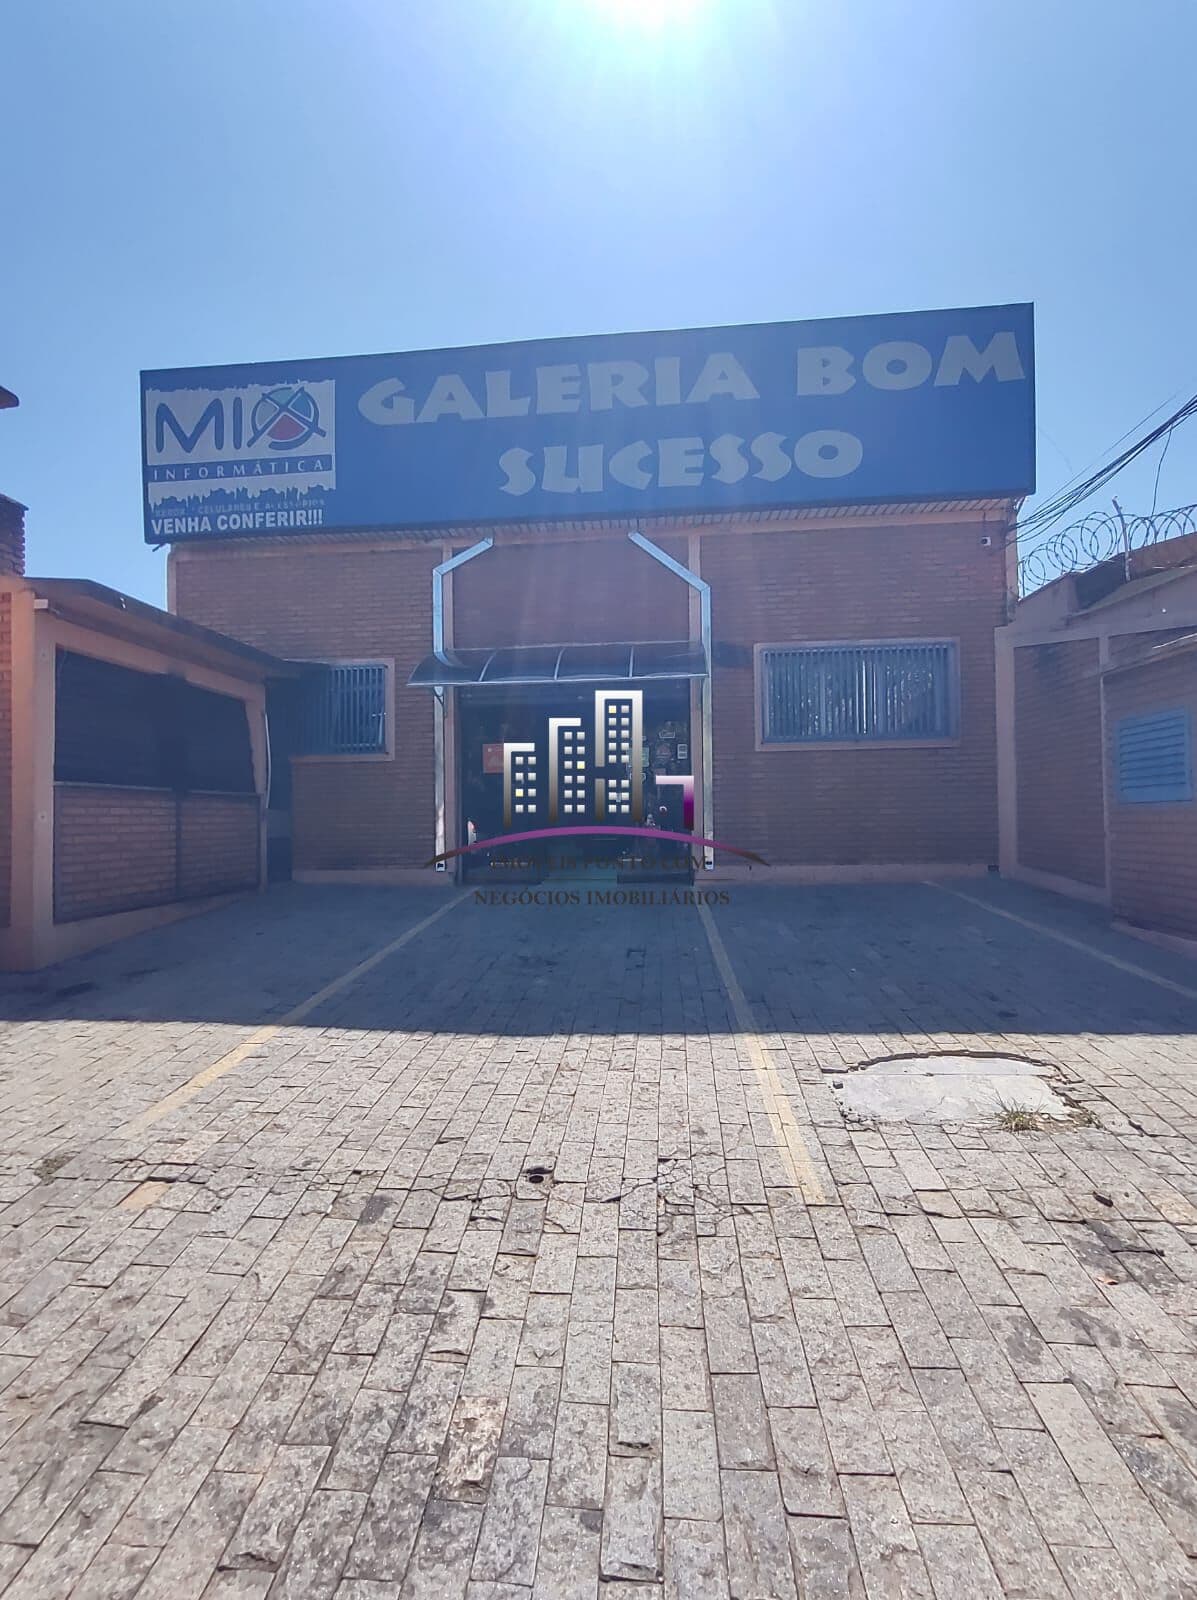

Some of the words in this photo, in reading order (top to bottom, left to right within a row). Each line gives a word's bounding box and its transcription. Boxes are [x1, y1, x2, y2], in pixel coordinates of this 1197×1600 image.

[358, 351, 760, 425] GALERIA
[797, 332, 1026, 396] BOM
[153, 459, 324, 481] INFORMÁTICA
[499, 429, 864, 496] SUCESSO
[151, 515, 212, 535] VENHA
[217, 508, 323, 530] CONFERIR!!!
